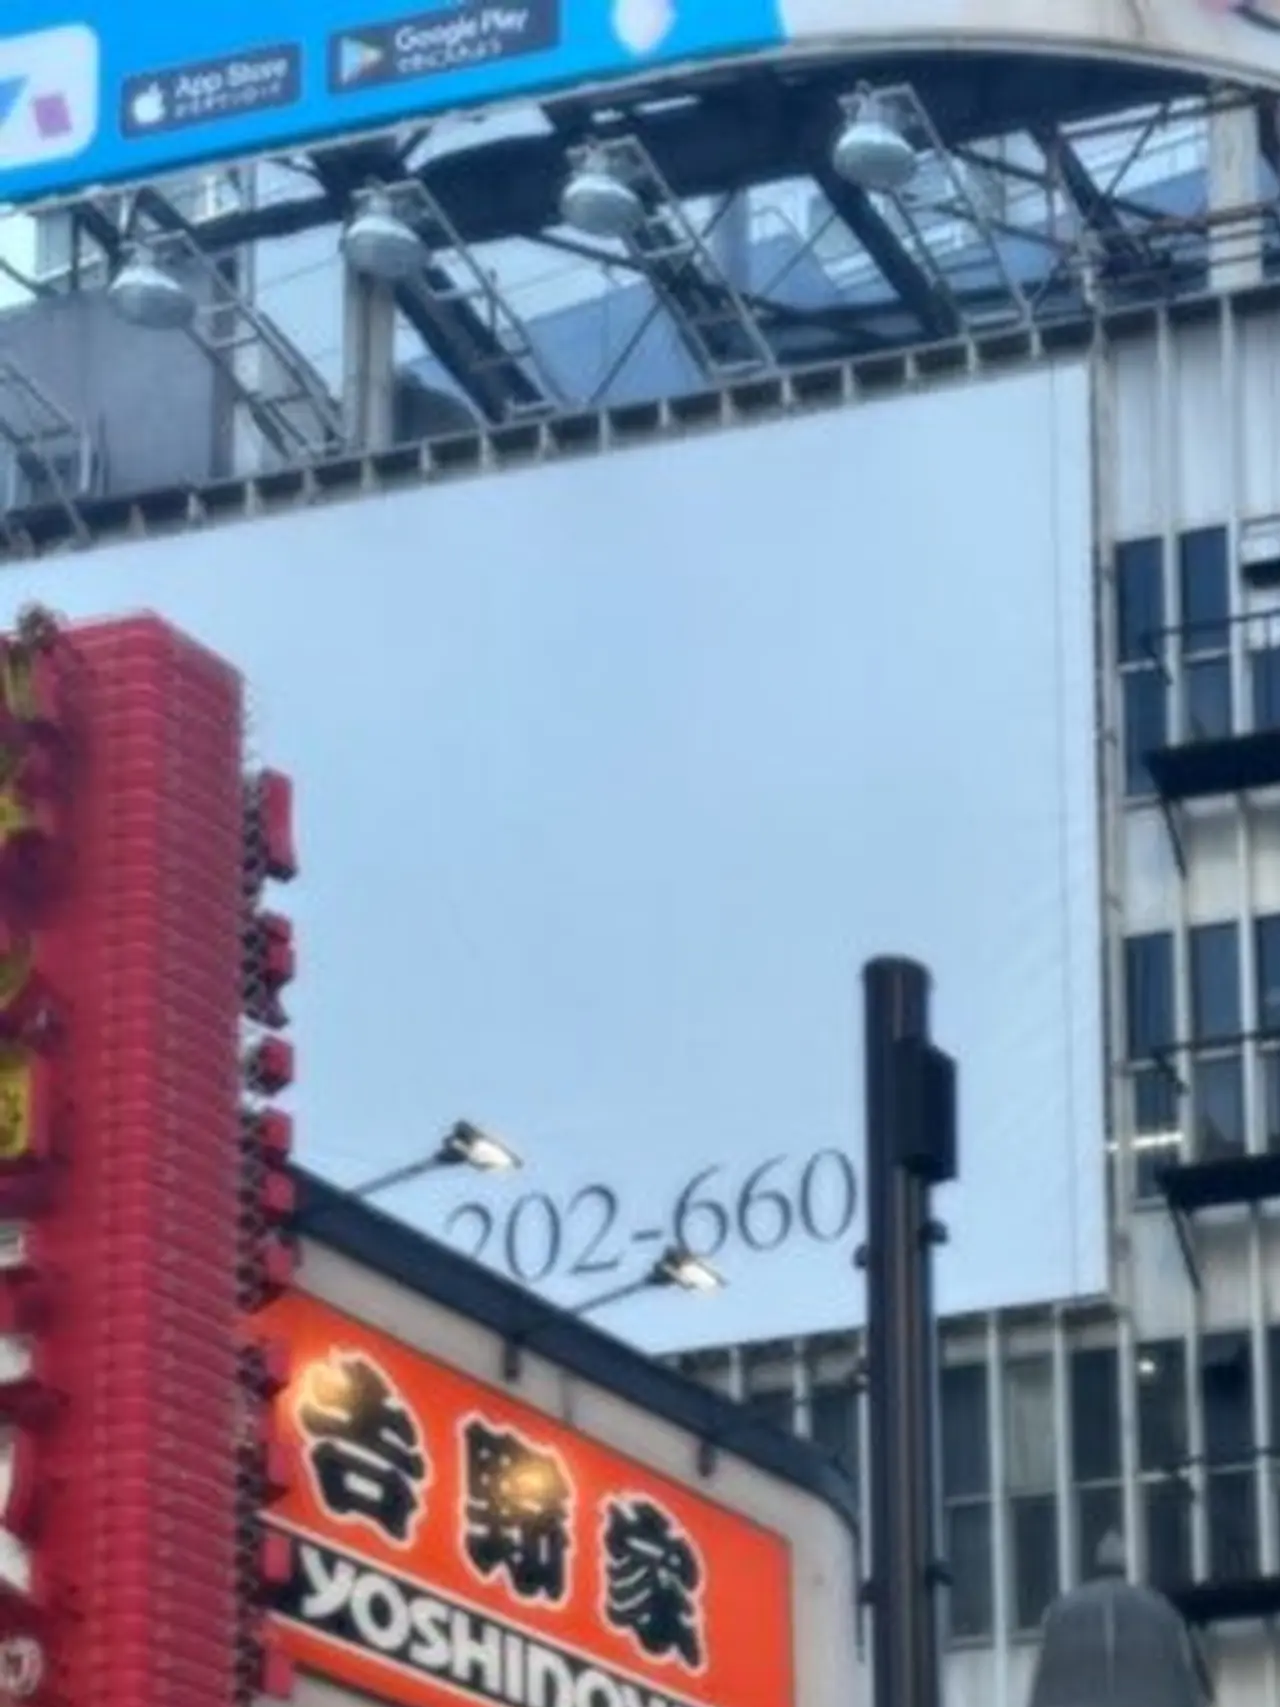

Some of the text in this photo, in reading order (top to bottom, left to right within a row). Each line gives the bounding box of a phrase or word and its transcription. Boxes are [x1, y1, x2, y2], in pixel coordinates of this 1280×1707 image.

[394, 8, 529, 51] Google Play
[175, 58, 288, 100] App Store
[444, 1148, 858, 1283] 202-660
[298, 1350, 705, 1673] 吉野家
